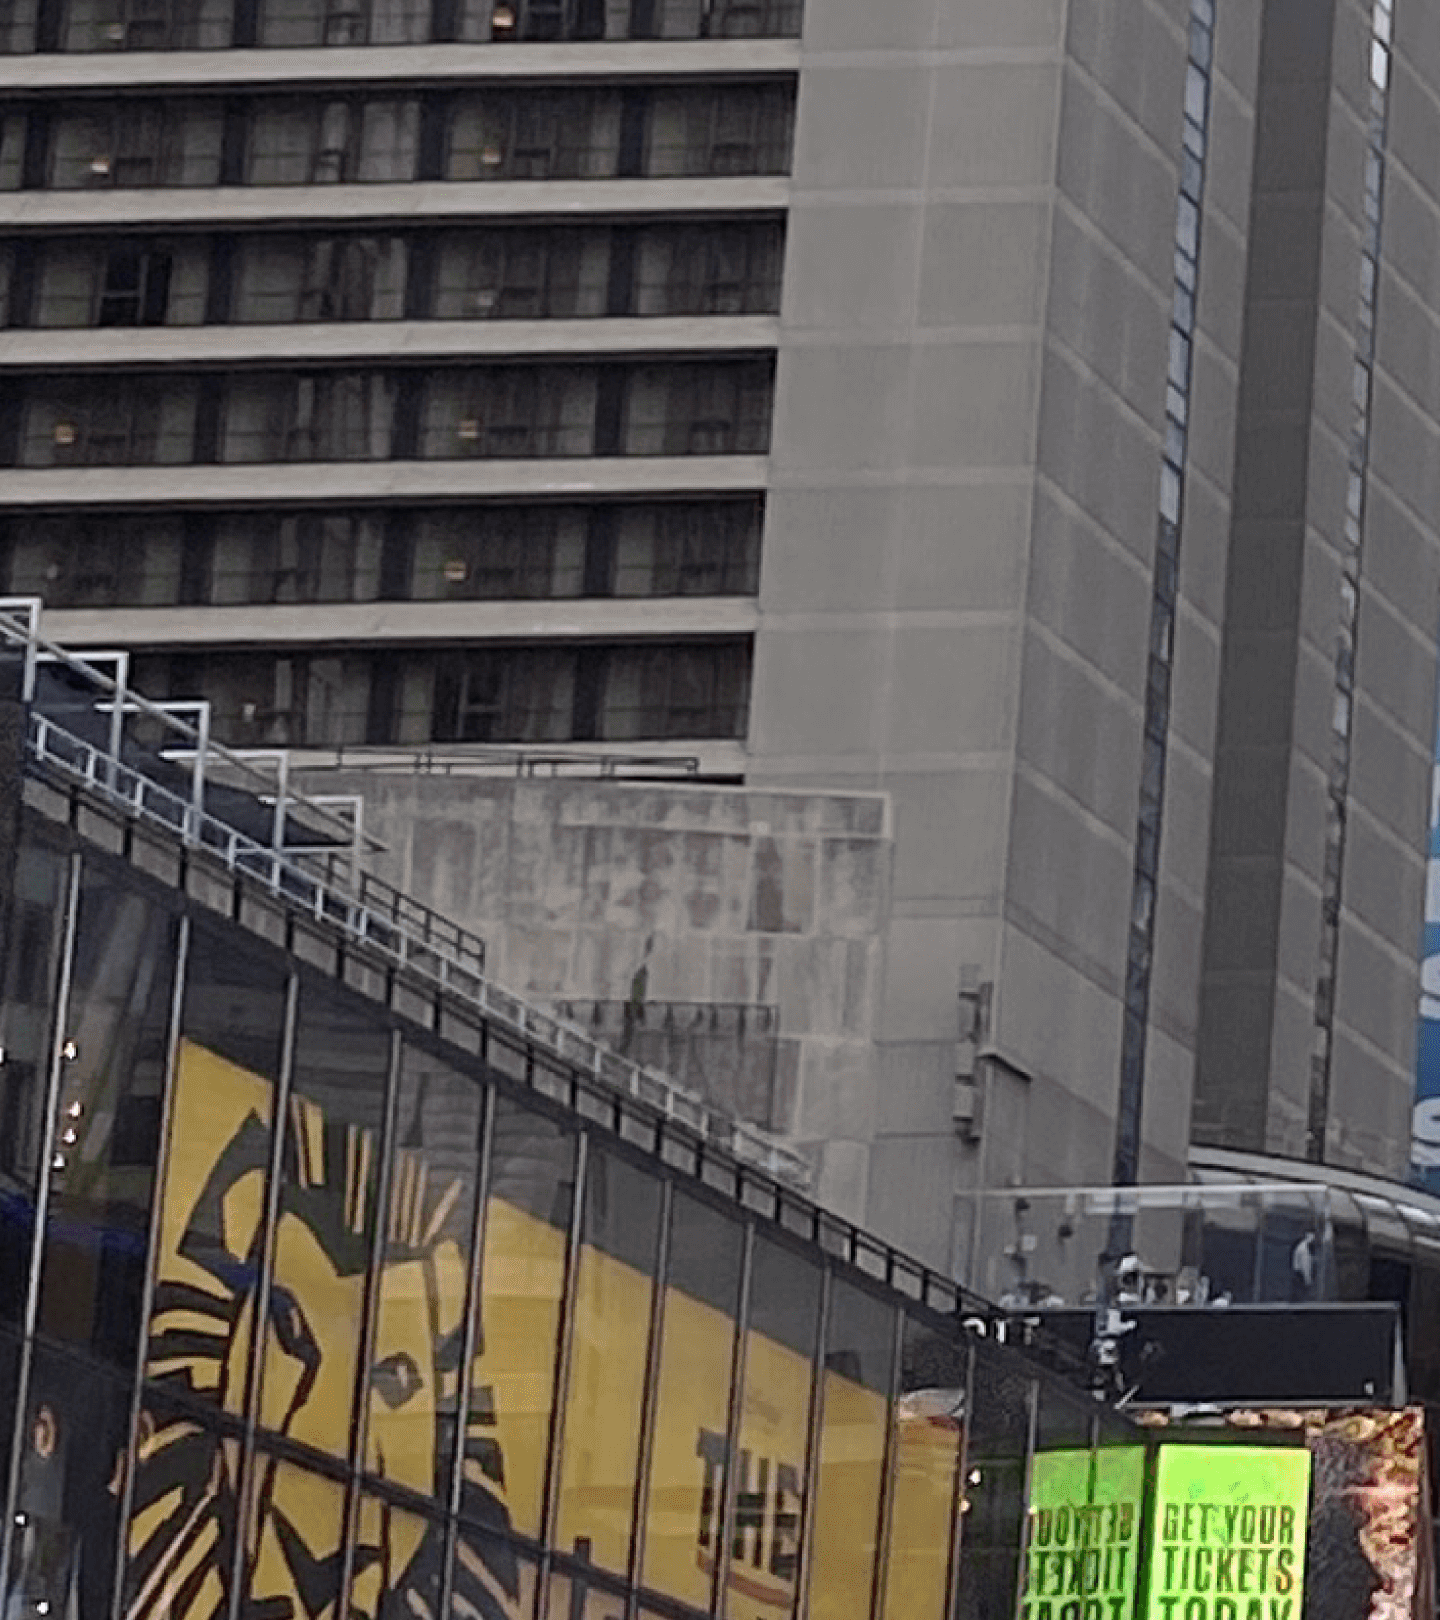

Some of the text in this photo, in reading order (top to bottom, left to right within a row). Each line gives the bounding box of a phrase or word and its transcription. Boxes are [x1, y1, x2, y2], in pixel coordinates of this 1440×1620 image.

[1162, 1502, 1297, 1546] GET YOUR
[1161, 1545, 1295, 1595] TICKETS
